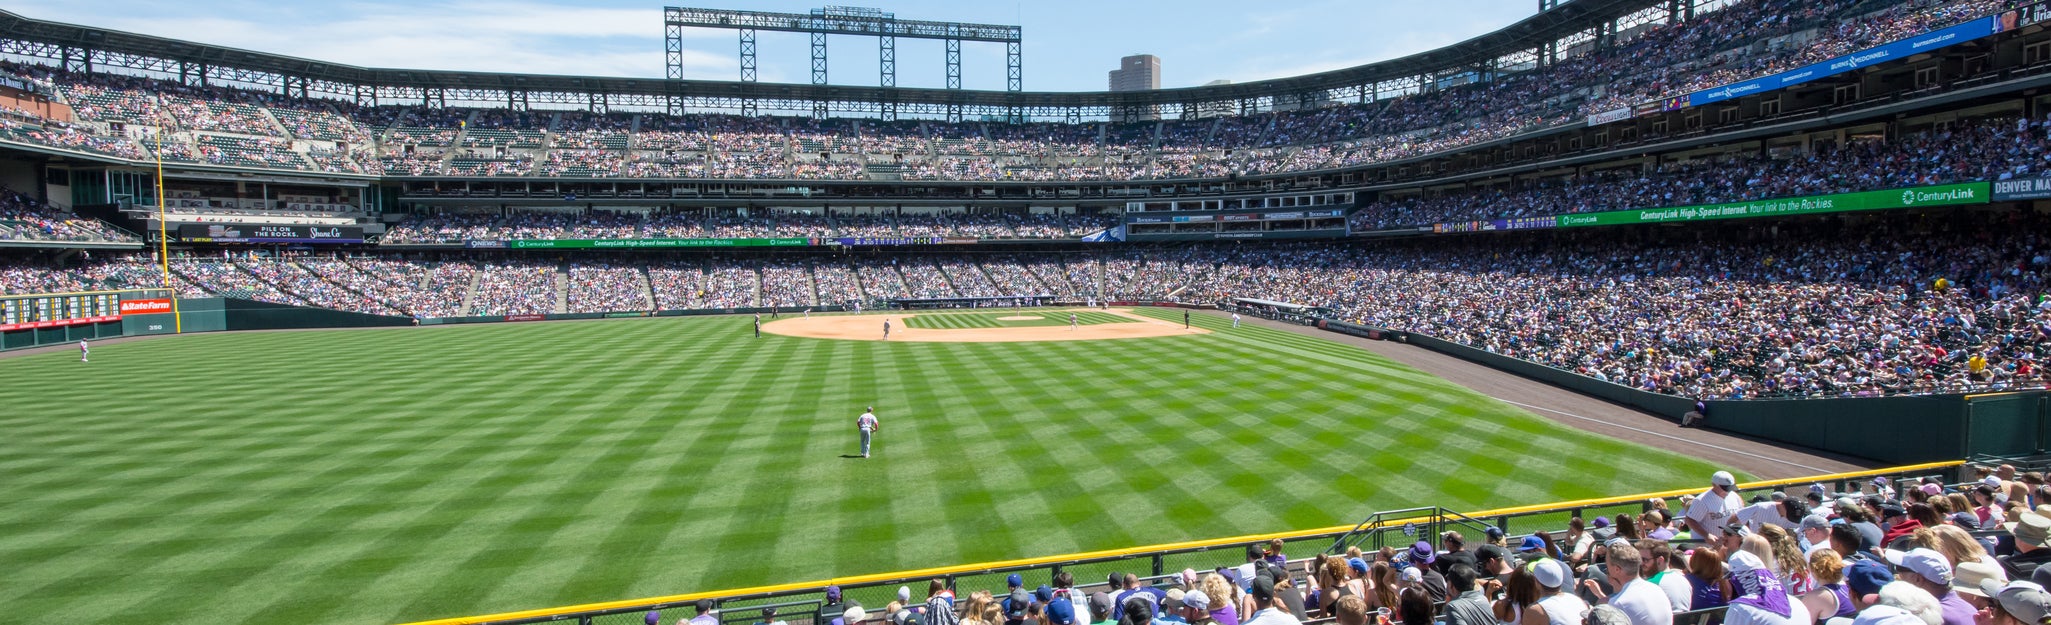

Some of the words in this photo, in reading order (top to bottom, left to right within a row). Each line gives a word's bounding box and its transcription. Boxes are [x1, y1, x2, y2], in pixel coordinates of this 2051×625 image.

[2022, 7, 2029, 18] 7
[2034, 9, 2051, 22] Uria
[1830, 60, 1849, 70] BURNS
[1995, 180, 2032, 194] DENVER
[2035, 178, 2051, 191] MA
[1916, 188, 1974, 203] CenturyLink
[1640, 209, 1679, 221] CenturyLink
[1680, 207, 1721, 219] High-Speed
[1749, 203, 1764, 213] Your
[1765, 202, 1777, 212] link
[1779, 202, 1786, 211] to
[1788, 200, 1799, 210] the
[1800, 198, 1833, 210] Rockies.
[1570, 216, 1598, 224] CenturyLink
[310, 226, 330, 239] Shane
